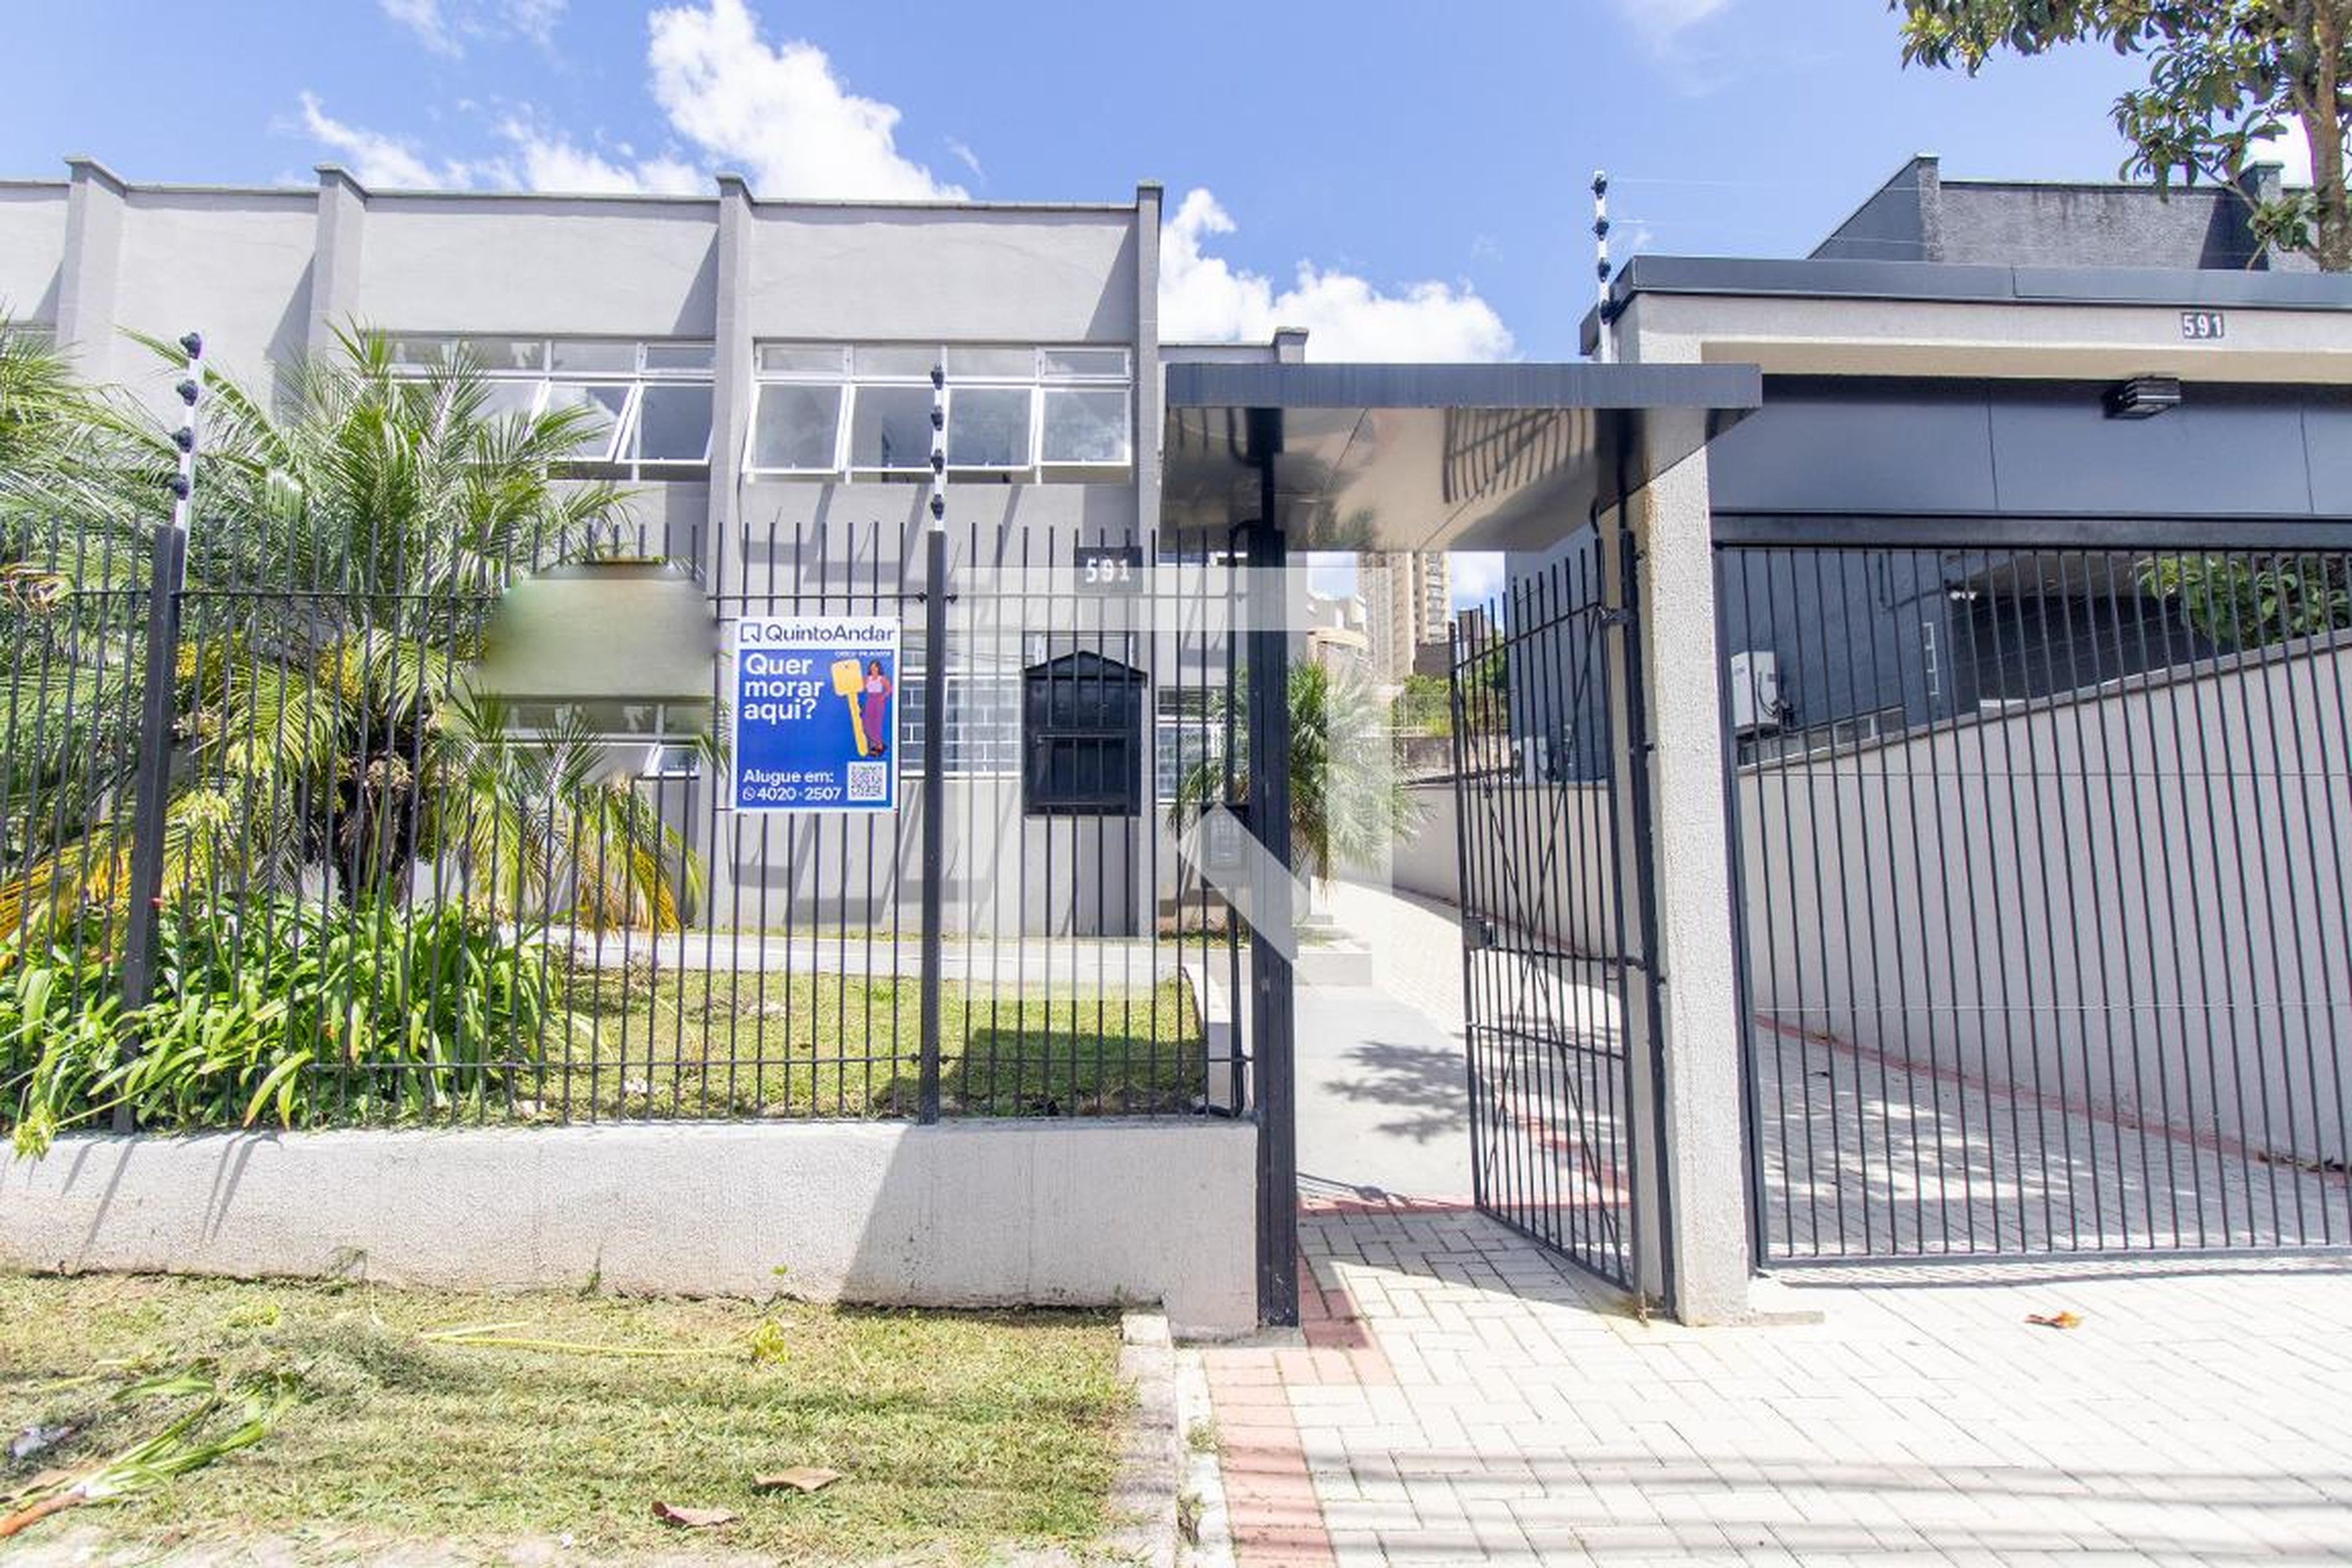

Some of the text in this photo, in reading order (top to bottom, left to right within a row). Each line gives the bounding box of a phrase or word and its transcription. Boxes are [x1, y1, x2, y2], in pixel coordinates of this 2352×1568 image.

[2184, 314, 2222, 336] 591
[1085, 557, 1130, 582] 591
[766, 624, 894, 641] QuintoAndar
[745, 653, 813, 674] Quer
[744, 680, 824, 697] morar
[744, 699, 816, 725] aqui?
[743, 769, 834, 786] Alugue em:
